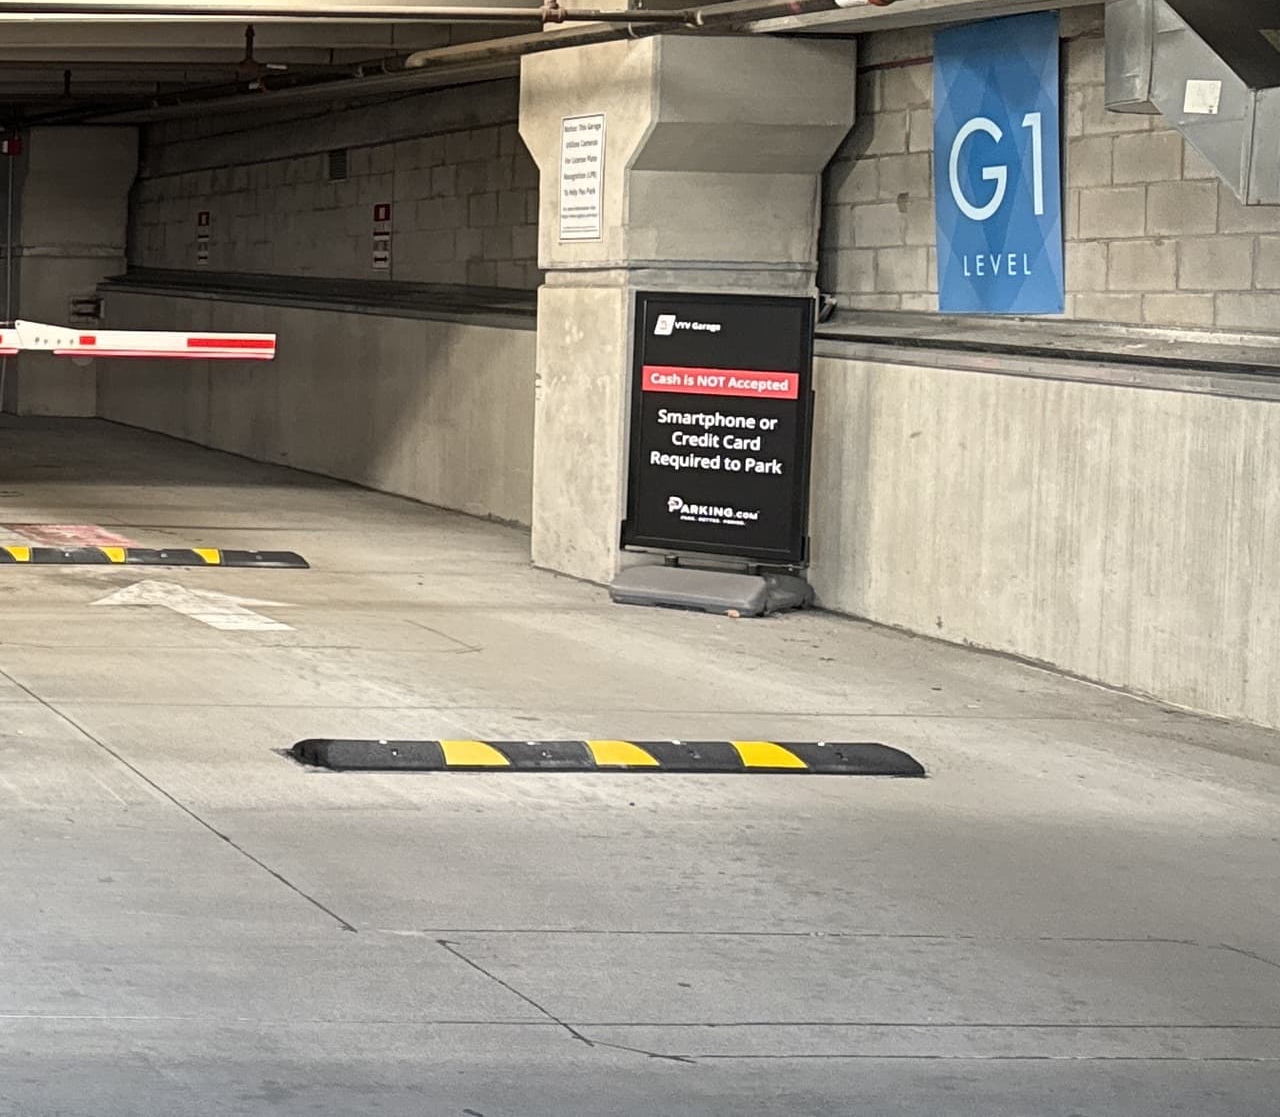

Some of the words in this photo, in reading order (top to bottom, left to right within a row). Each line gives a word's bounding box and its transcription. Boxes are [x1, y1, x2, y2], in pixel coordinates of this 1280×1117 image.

[949, 112, 1044, 221] G1
[963, 253, 1032, 277] LEVEL
[691, 322, 722, 332] Garage
[650, 373, 681, 385] Cash
[683, 374, 695, 386] is
[697, 375, 726, 388] NOT
[728, 377, 789, 392] Accepted
[657, 408, 756, 430] Smartphone
[759, 418, 778, 430] or
[671, 431, 719, 448] Credit
[723, 434, 761, 451] Card
[650, 450, 721, 470] Required
[724, 457, 741, 471] to
[744, 457, 783, 474] Park
